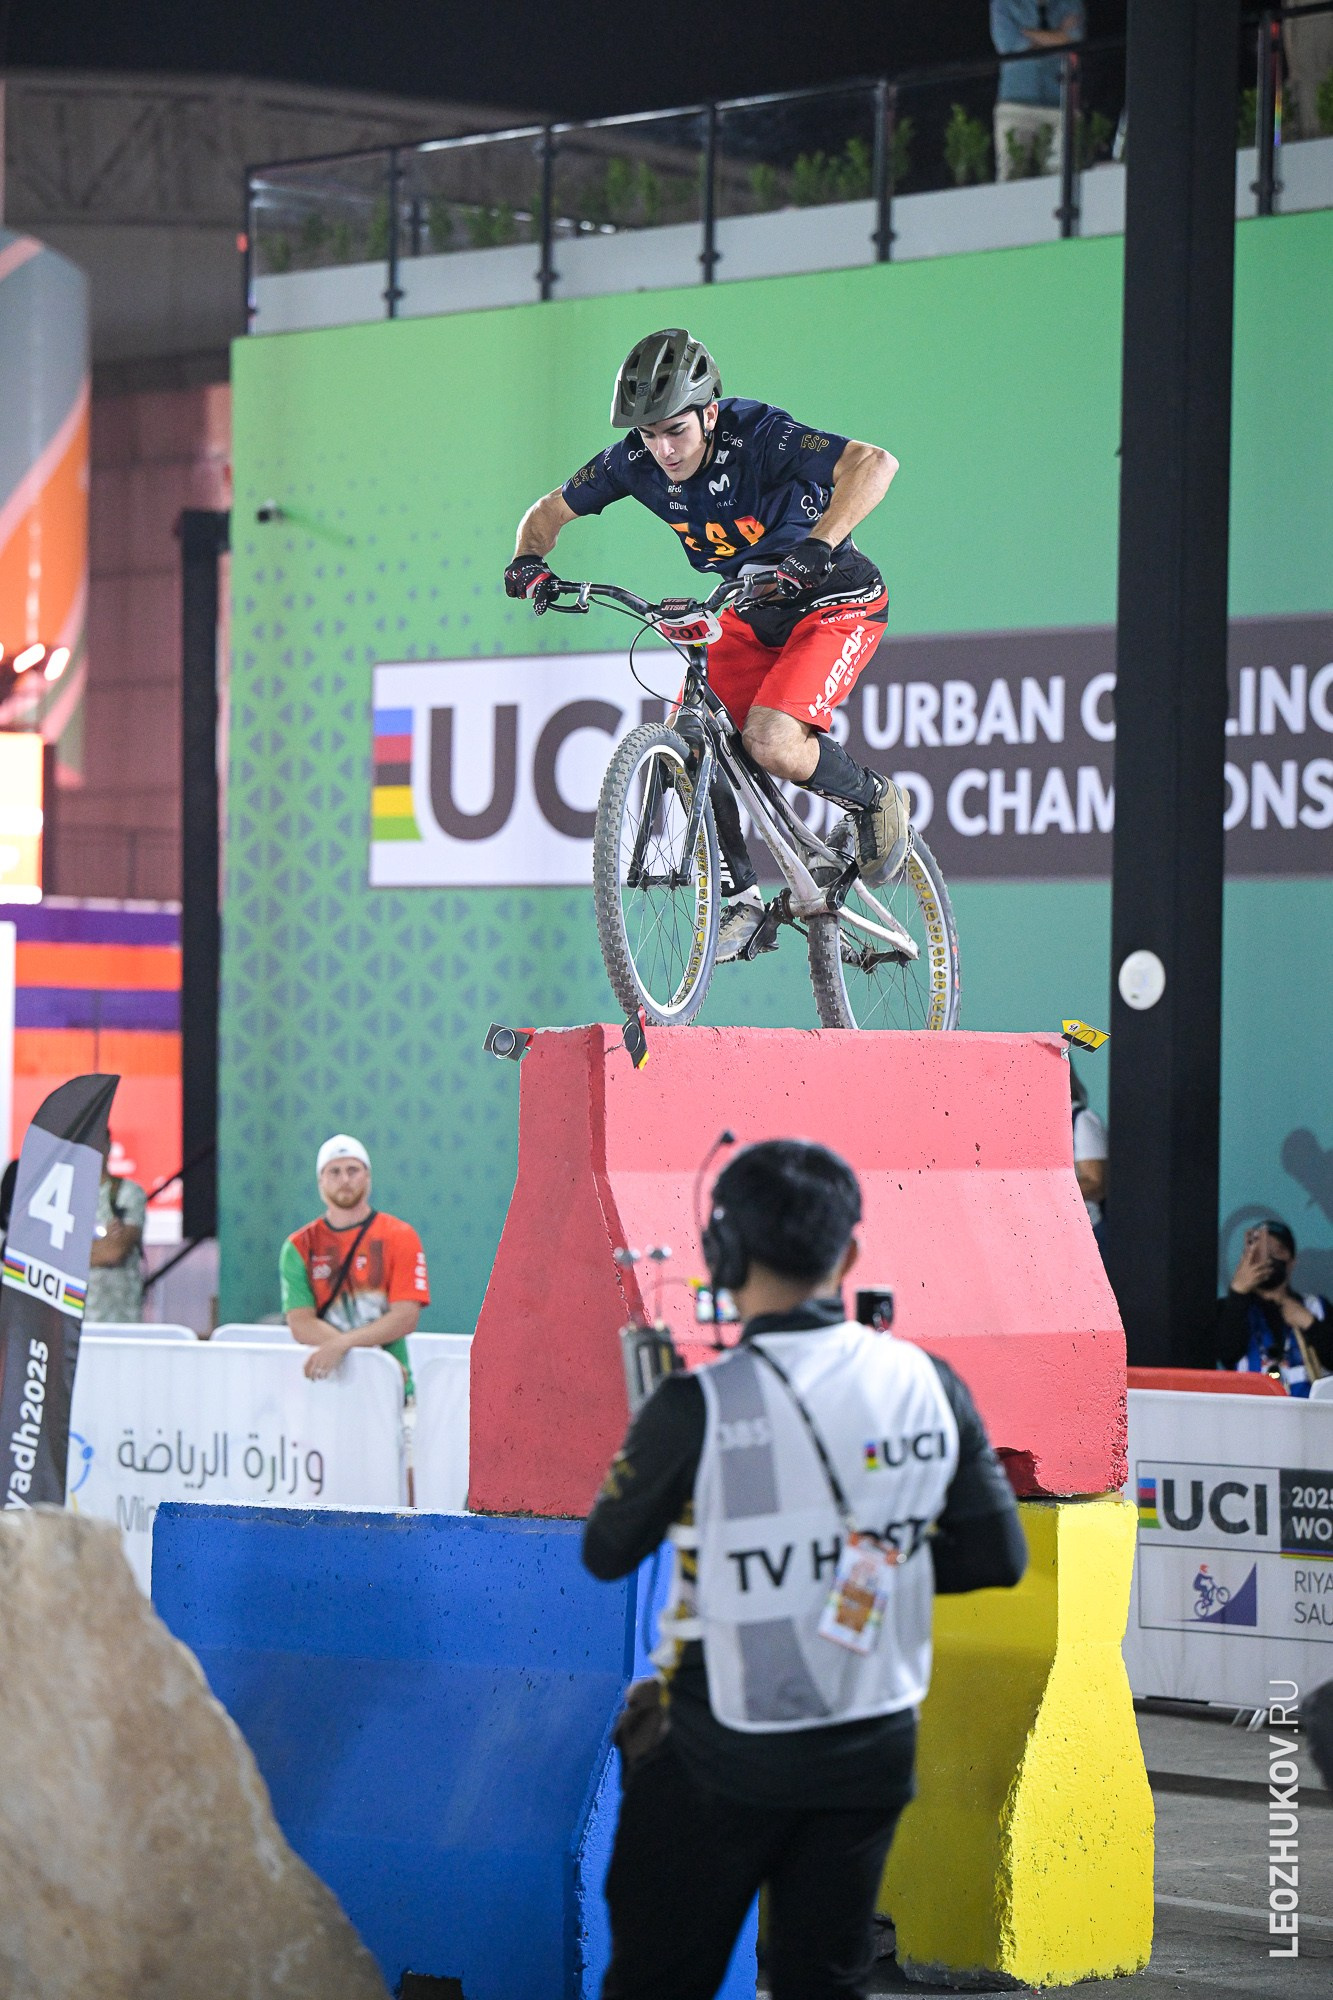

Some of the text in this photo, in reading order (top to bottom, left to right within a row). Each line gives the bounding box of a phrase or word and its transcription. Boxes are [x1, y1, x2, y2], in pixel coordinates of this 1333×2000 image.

[666, 625, 703, 639] 201
[862, 675, 1065, 750] URBAN
[28, 1162, 75, 1250] 4
[27, 1264, 62, 1300] UCI
[117, 1428, 324, 1496] وزارة الرياضة
[882, 1431, 947, 1468] UCI
[1162, 1478, 1268, 1536] UCI
[728, 1546, 792, 1592] TV
